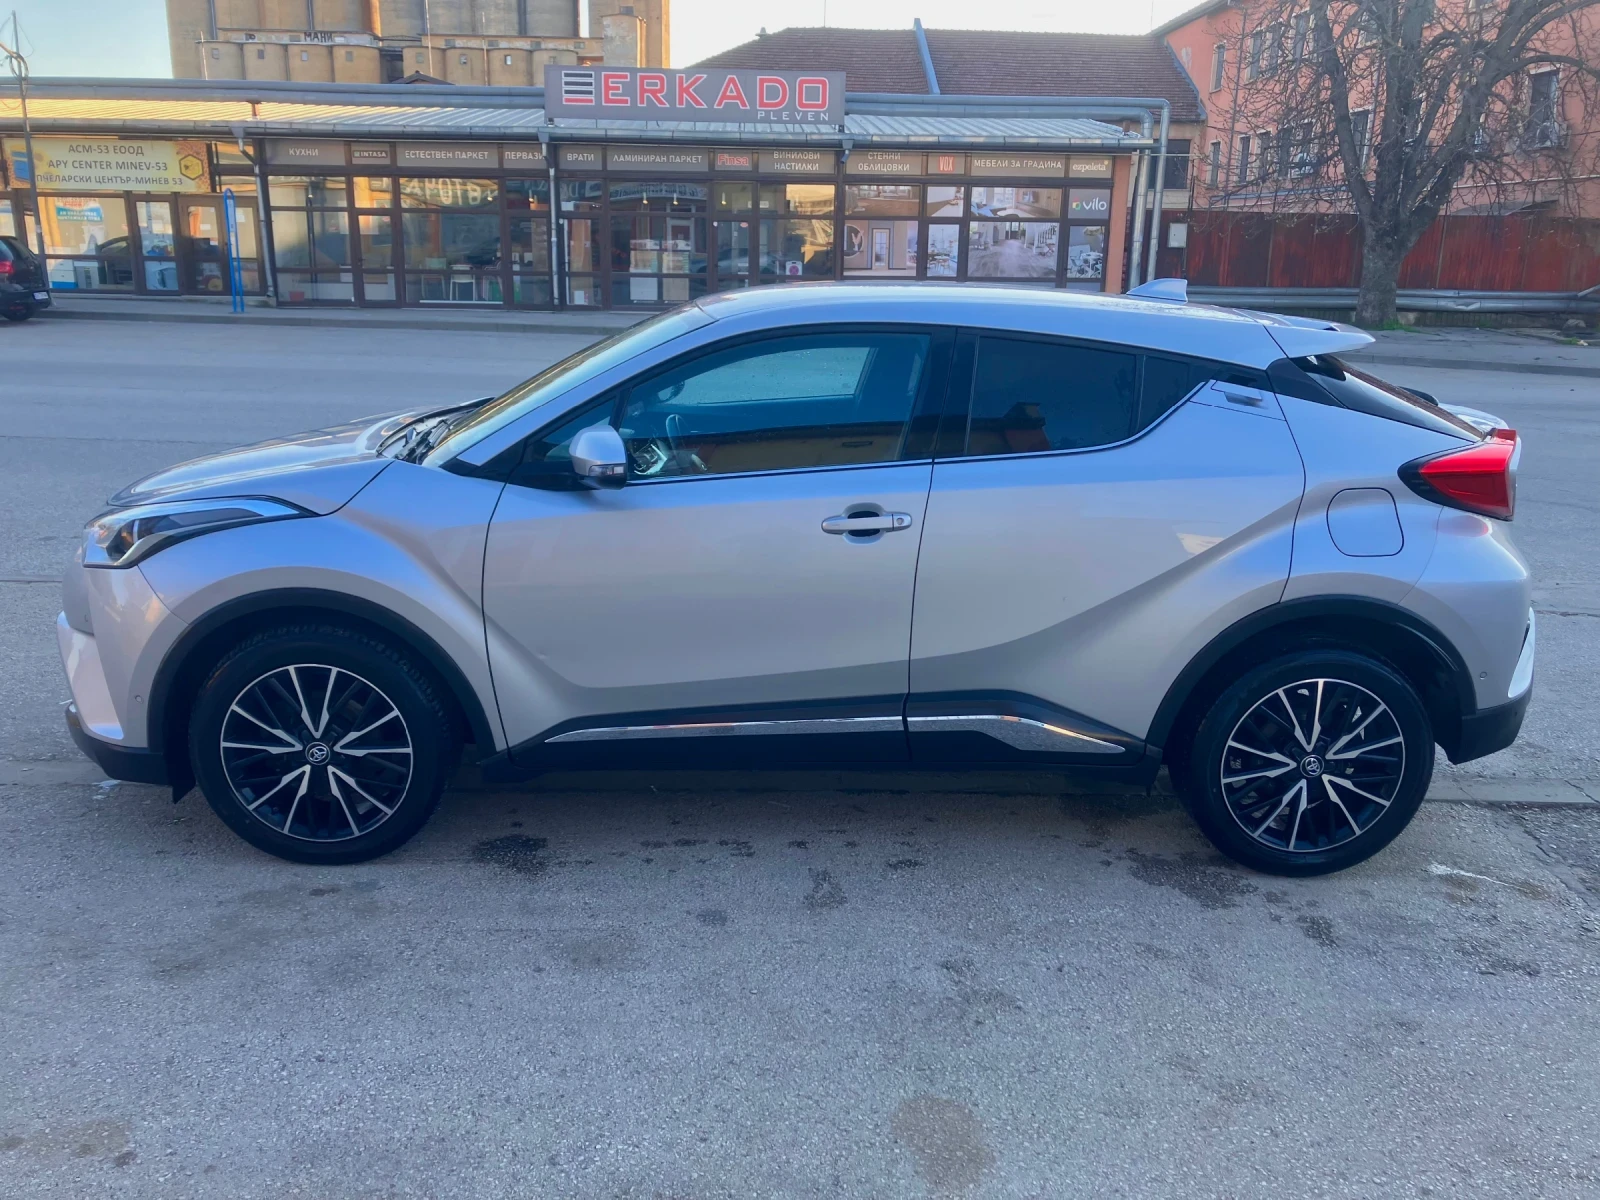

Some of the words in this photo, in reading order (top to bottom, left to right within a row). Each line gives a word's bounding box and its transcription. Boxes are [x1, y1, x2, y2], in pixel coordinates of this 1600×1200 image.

[601, 71, 829, 111] ERKADO
[757, 111, 829, 121] PLEVEN
[68, 144, 110, 154] АСМ-53
[113, 145, 144, 156] ЕООД
[288, 148, 319, 156] КУХНИ
[405, 150, 452, 159] ЕСТЕСТВЕН
[455, 152, 489, 160] ПАРКЕТ
[566, 153, 594, 161] ВРАТИ
[612, 154, 667, 163] ЛАМИНИРАН
[669, 155, 702, 163] ПАРКЕТ
[717, 154, 749, 165] Finsa
[773, 151, 820, 160] ВИНИЛОВИ
[867, 152, 901, 160] СТЕННИ
[71, 160, 112, 170] CENTER
[115, 161, 168, 171] MINEV-53
[774, 162, 819, 171] НАСТИЛКИ
[858, 162, 910, 172] ОБЛИЦОВКИ
[939, 156, 954, 171] VOX
[974, 159, 1008, 168] МЕБЕЛИ
[1010, 160, 1021, 168] ЗА
[1023, 160, 1062, 170] ГРАДИНА
[1072, 162, 1106, 173] ezpeleta
[36, 173, 92, 184] ПЧЕЛАРСКИ
[95, 175, 170, 185] ЦЕНТЪР-МИНЕВ
[172, 177, 183, 185] 53
[1082, 197, 1107, 211] vilo
